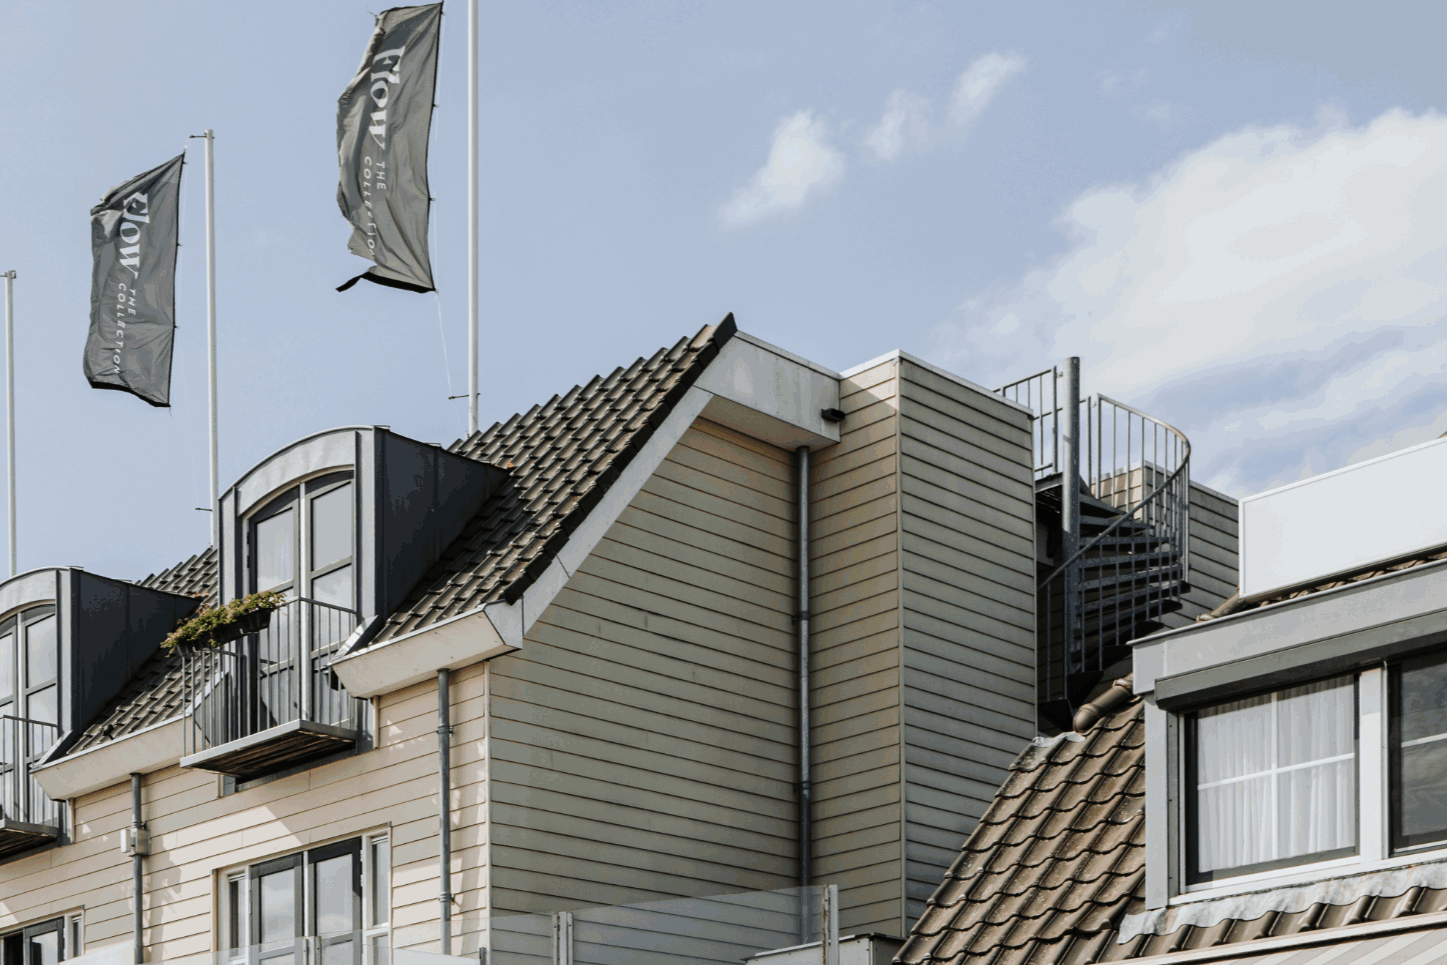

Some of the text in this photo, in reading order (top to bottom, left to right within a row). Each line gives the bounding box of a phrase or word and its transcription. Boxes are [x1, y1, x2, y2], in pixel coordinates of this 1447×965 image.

[369, 45, 406, 150] Flow
[376, 161, 386, 190] THE
[119, 192, 150, 280] Flow
[113, 283, 127, 374] COLLECTION
[128, 288, 137, 315] THE
